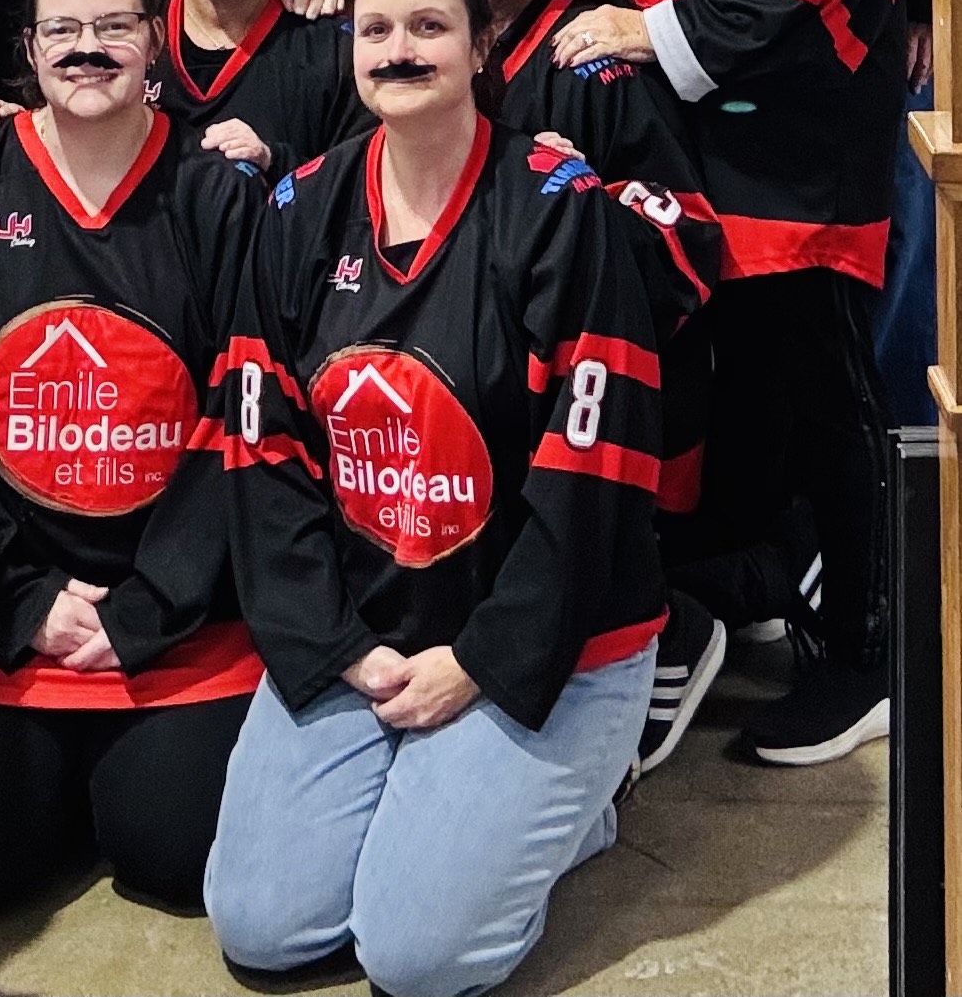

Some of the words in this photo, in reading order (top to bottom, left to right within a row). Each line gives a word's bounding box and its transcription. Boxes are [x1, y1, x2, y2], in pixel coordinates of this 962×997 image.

[8, 371, 119, 410] Emile
[240, 361, 261, 444] 8
[567, 359, 608, 448] 8
[6, 415, 183, 453] Bilodeau
[326, 415, 421, 456] Emile
[54, 458, 84, 485] et
[95, 457, 136, 486] fils
[336, 452, 476, 504] Bilodeau
